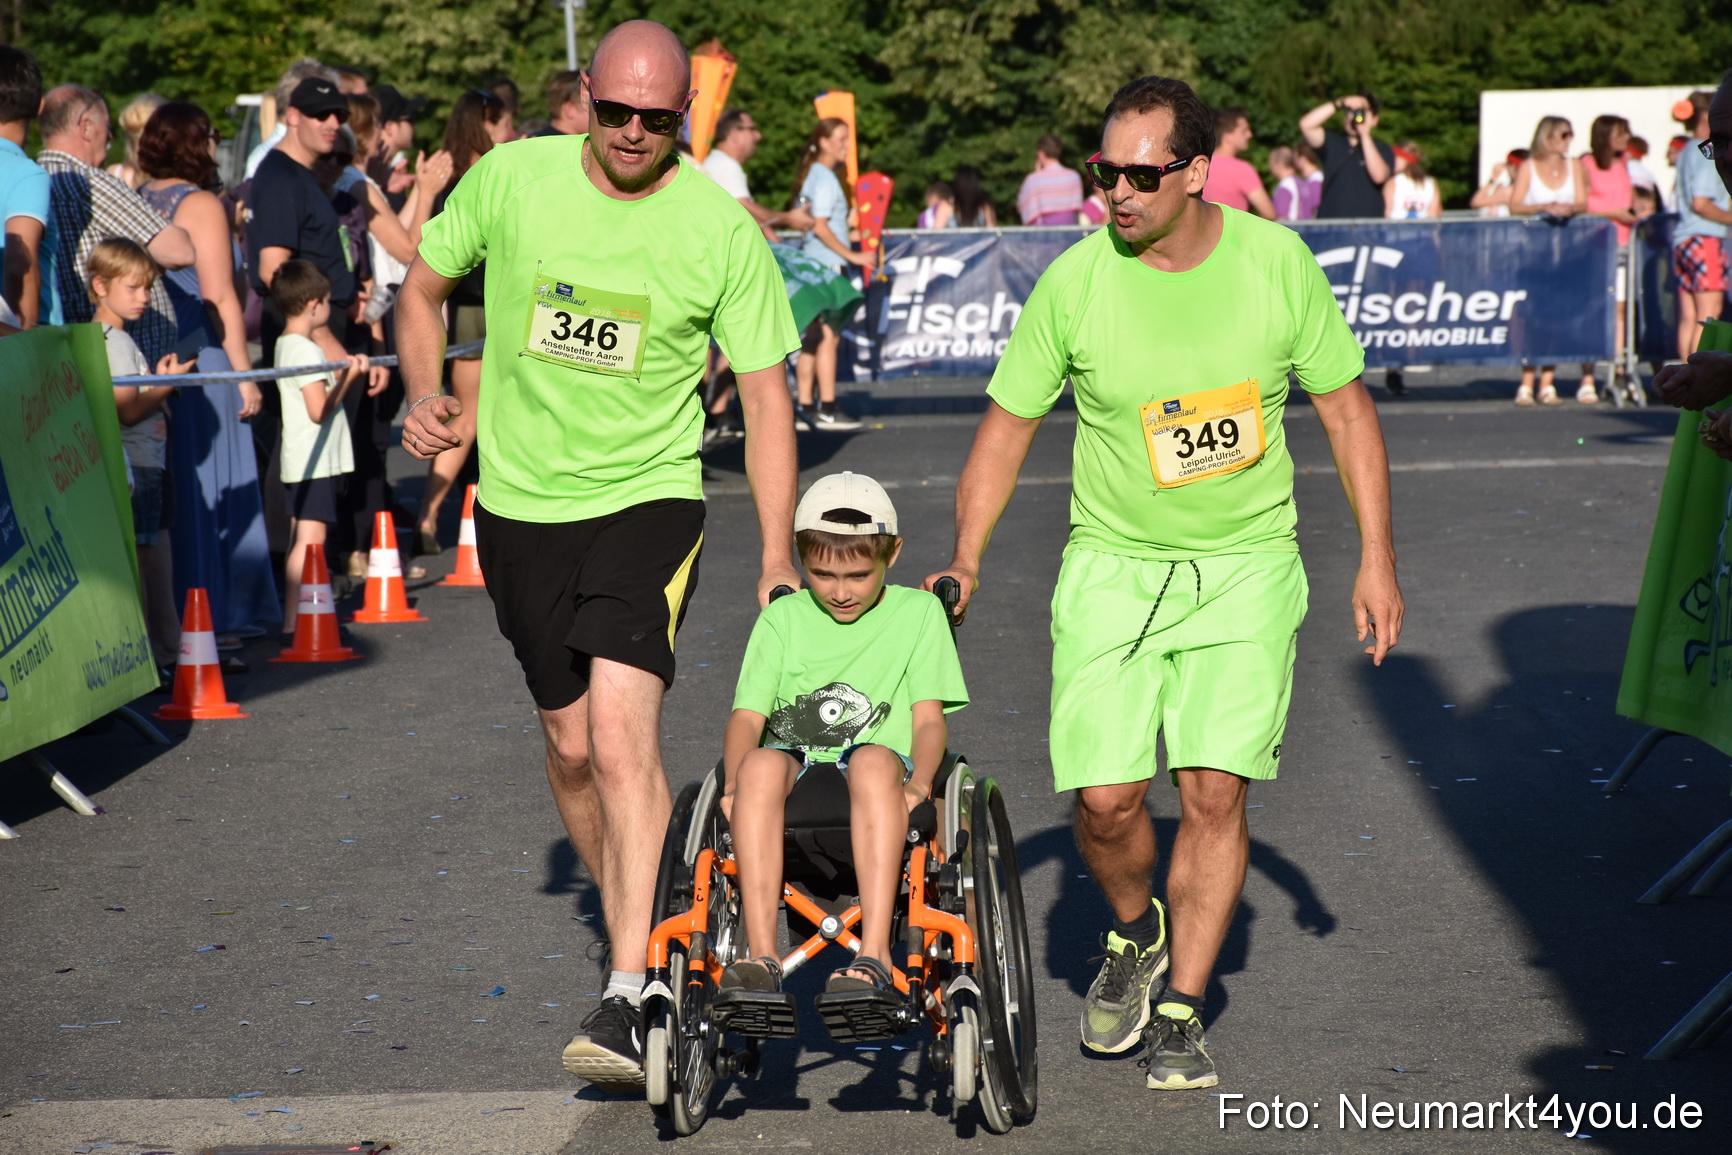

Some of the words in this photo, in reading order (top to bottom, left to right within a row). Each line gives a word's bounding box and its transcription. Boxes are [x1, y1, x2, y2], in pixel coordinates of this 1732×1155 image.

[547, 290, 587, 306] firmenlauf
[551, 311, 618, 350] 346
[540, 338, 594, 358] Anselstetter
[597, 349, 624, 362] Aaron
[545, 347, 596, 365] CAMPING-PROFI
[597, 359, 617, 368] GmbH
[1157, 406, 1197, 422] firmenlauf
[1173, 418, 1239, 459] 349
[1178, 461, 1228, 477] CAMPING-PROFI
[1228, 454, 1246, 465] GmbH
[1181, 453, 1214, 469] Leipold
[1215, 448, 1241, 461] Ulrich
[10, 626, 54, 687] neumarkt
